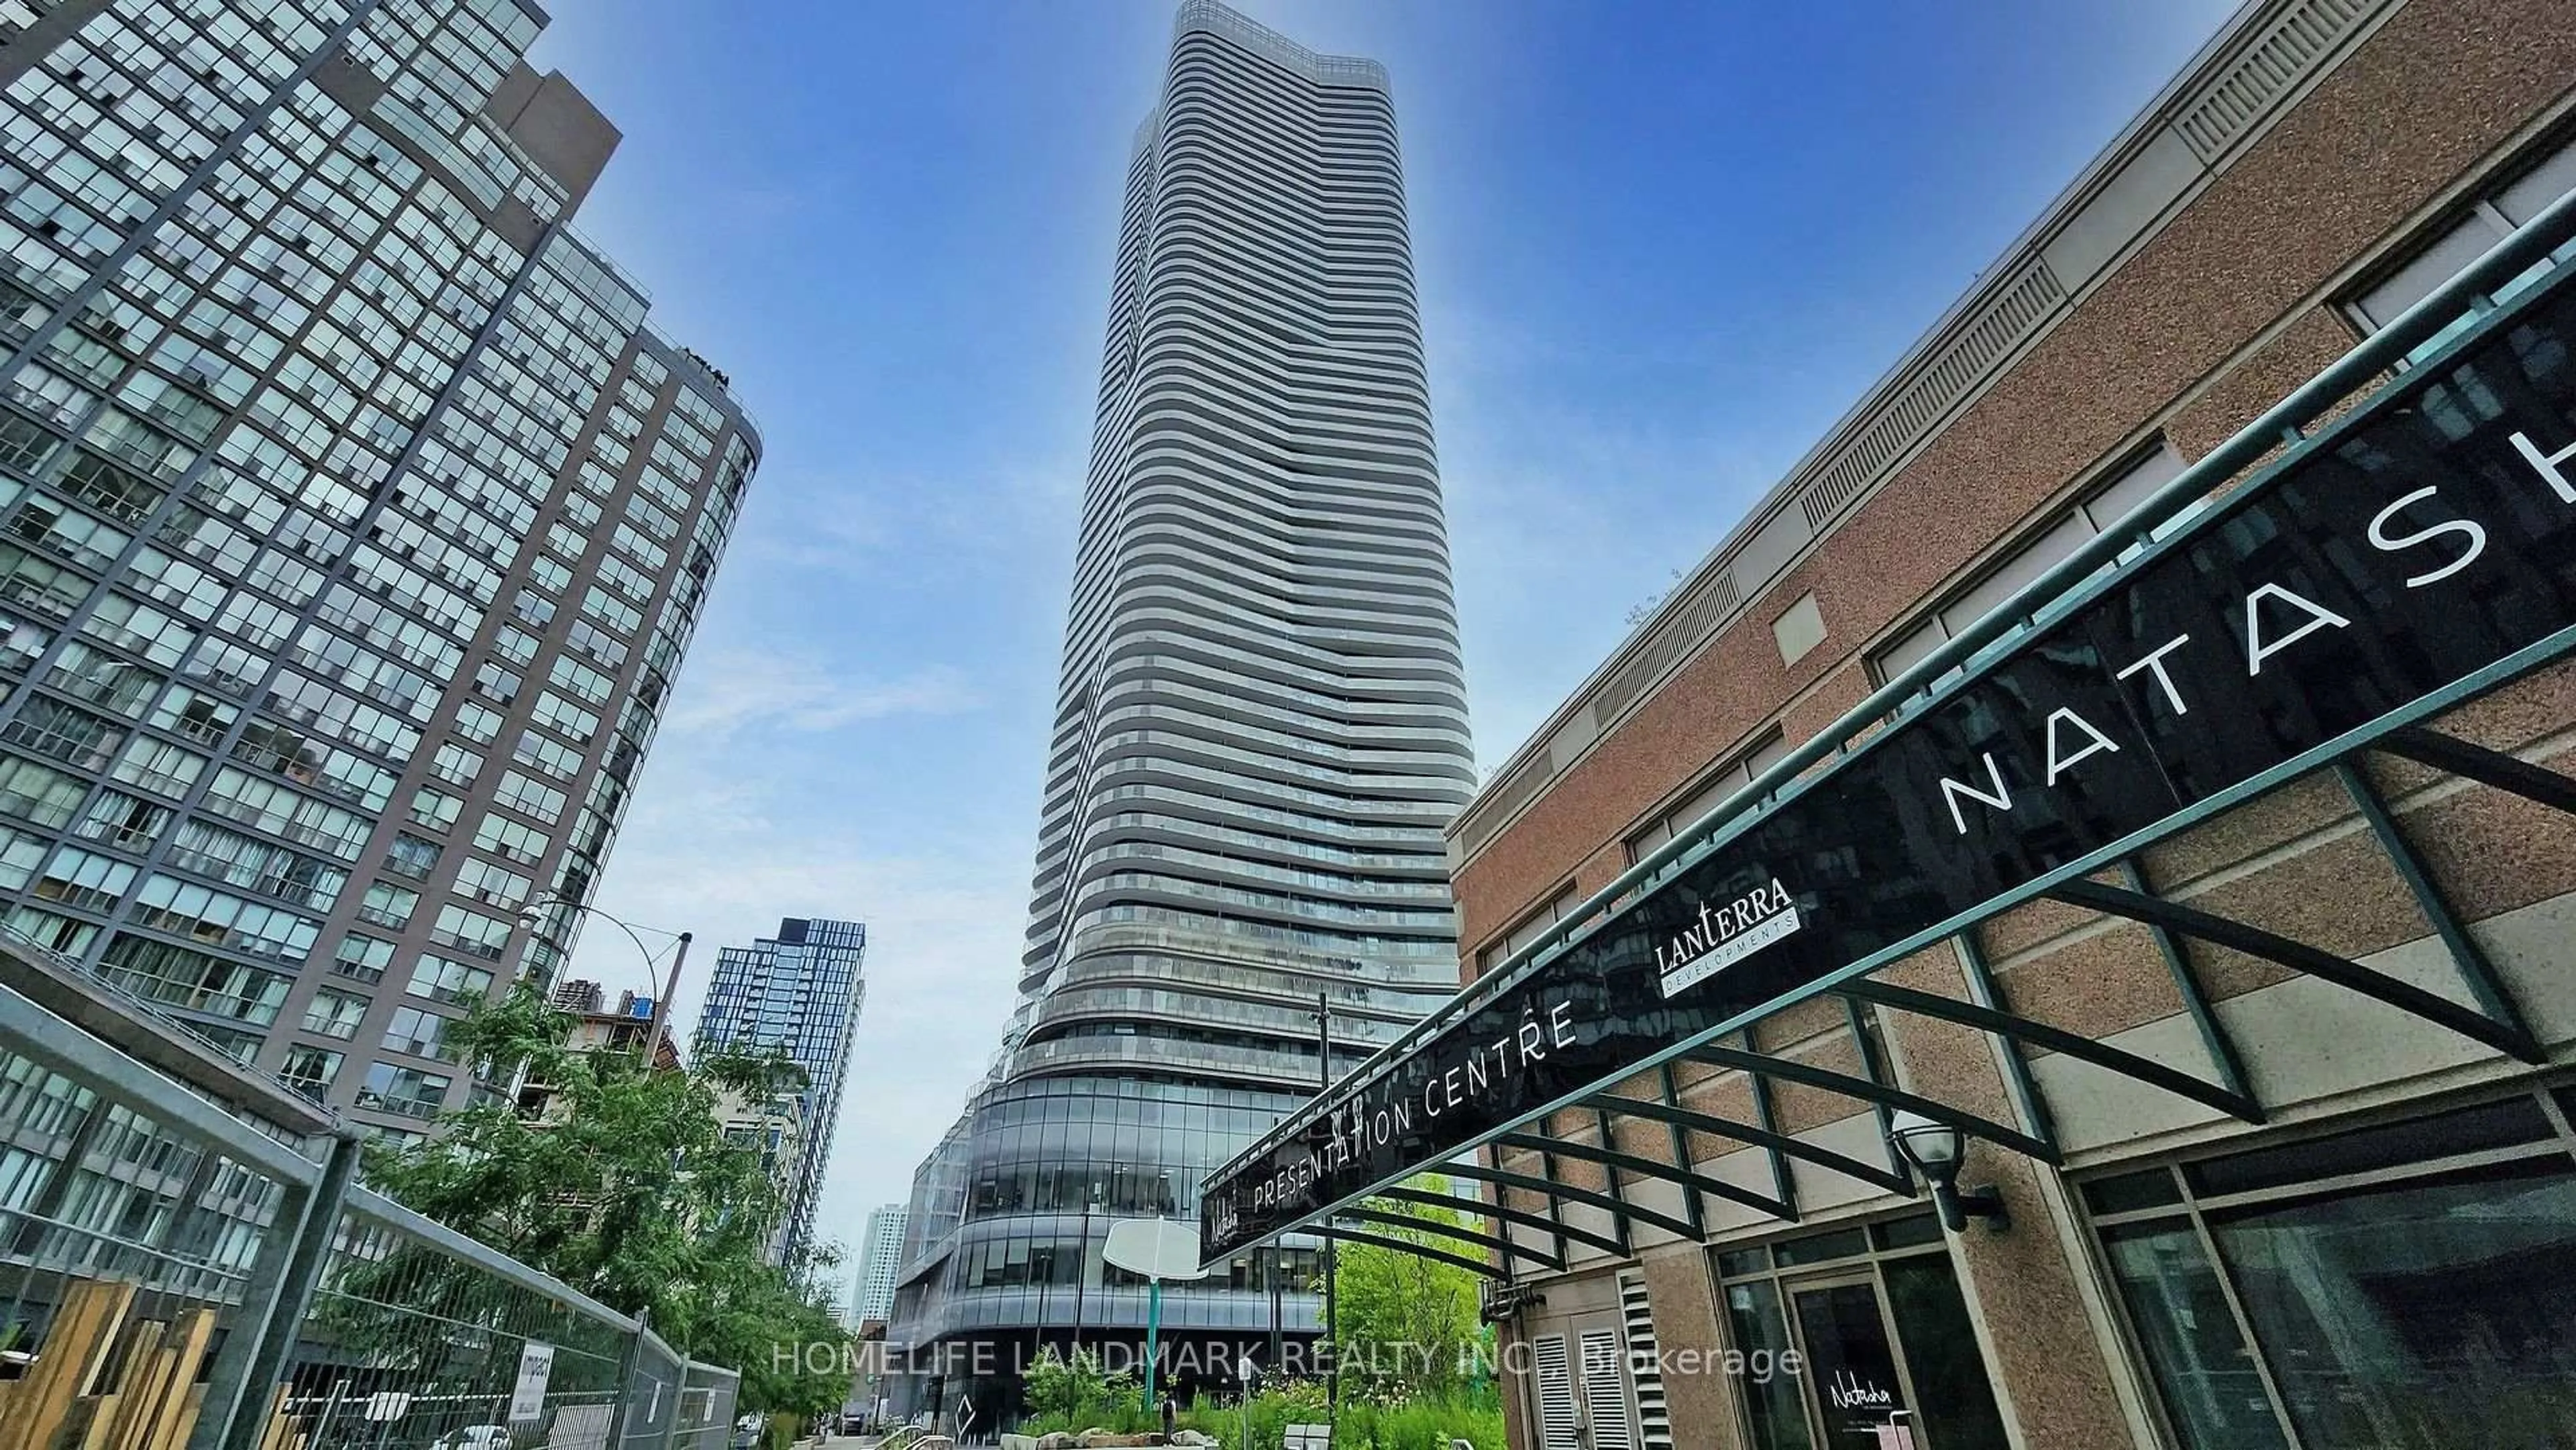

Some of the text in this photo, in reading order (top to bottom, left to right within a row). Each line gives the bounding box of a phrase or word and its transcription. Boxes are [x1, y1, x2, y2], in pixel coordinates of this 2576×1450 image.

[1665, 915, 1794, 991] DEVELOPMENTS
[1254, 1000, 1576, 1213] PRESENTATION CENTRE
